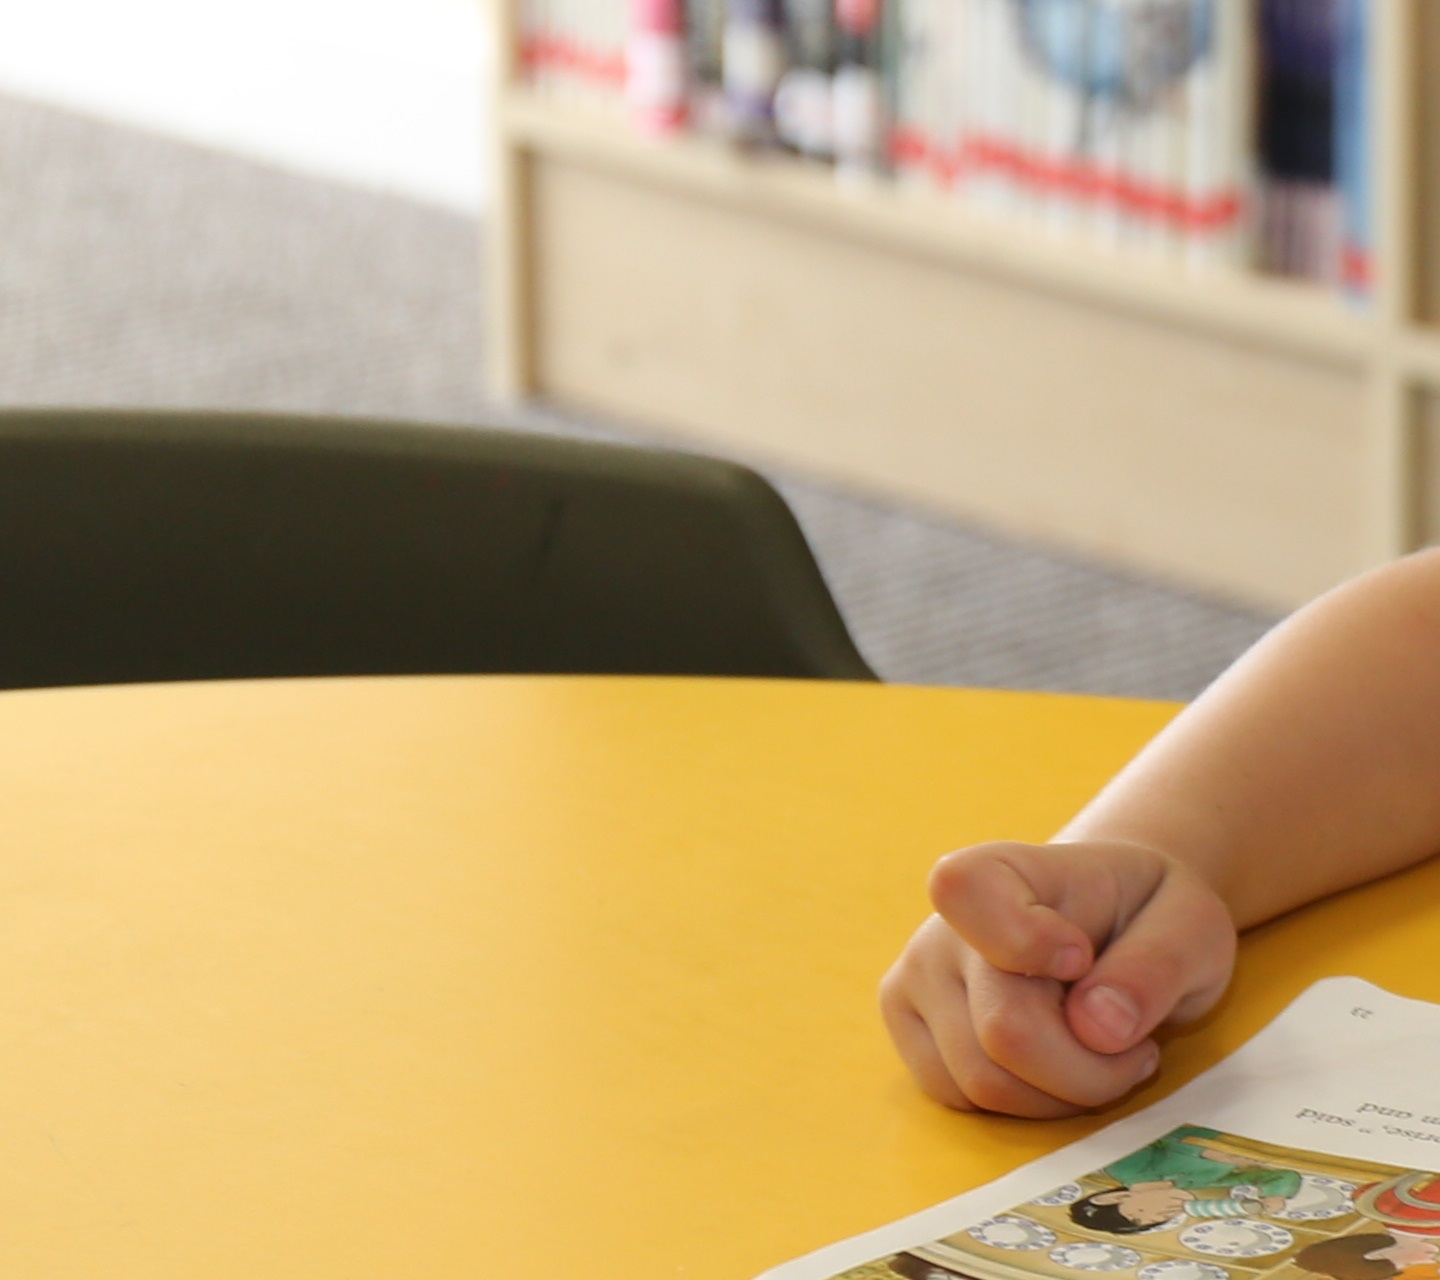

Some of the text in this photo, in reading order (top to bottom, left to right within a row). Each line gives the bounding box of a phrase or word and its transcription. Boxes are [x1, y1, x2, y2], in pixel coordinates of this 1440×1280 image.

[1349, 1006, 1375, 1020] 23
[1295, 1106, 1355, 1129] said
[1355, 1101, 1413, 1121] and
